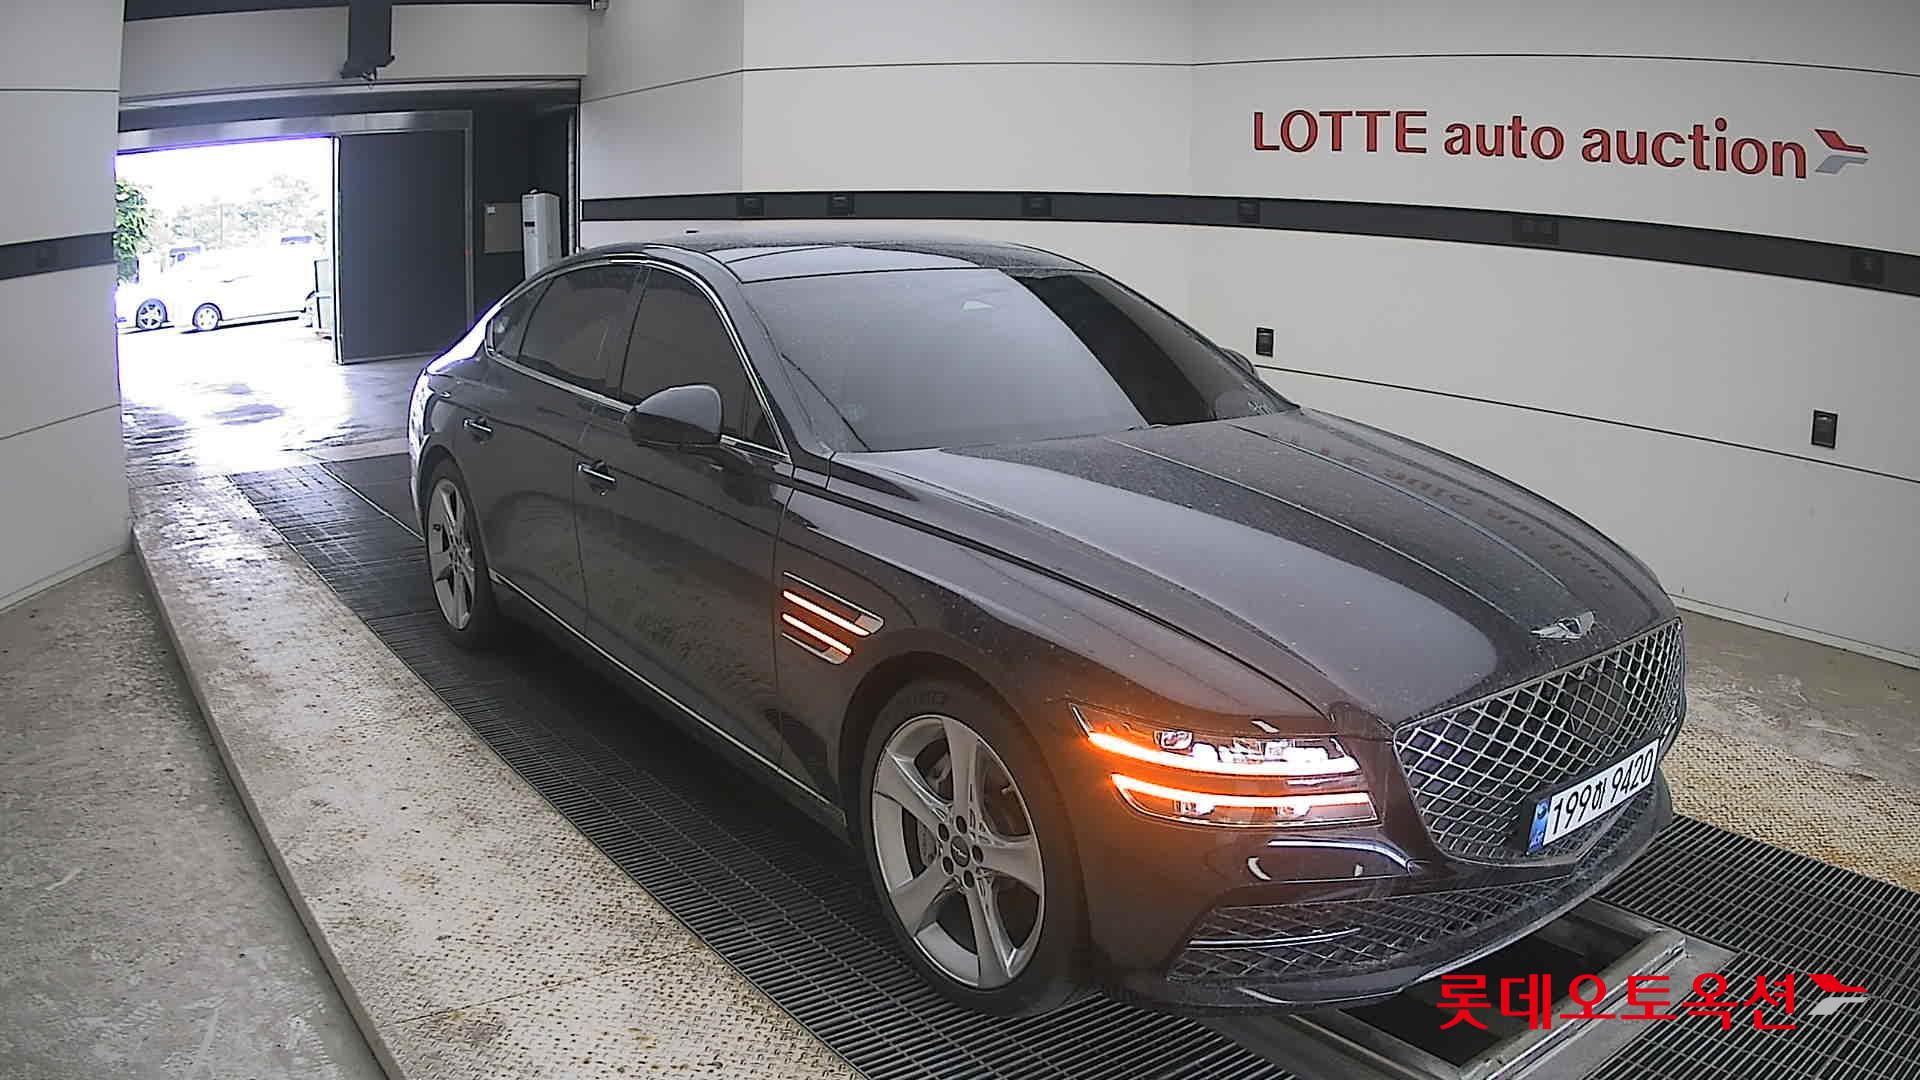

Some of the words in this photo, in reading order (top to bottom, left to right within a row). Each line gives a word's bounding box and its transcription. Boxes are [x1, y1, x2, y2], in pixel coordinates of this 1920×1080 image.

[1253, 110, 1427, 154] LOTTE
[1443, 115, 1565, 160] auto
[1581, 117, 1807, 179] auction
[1611, 748, 1654, 803] 9420
